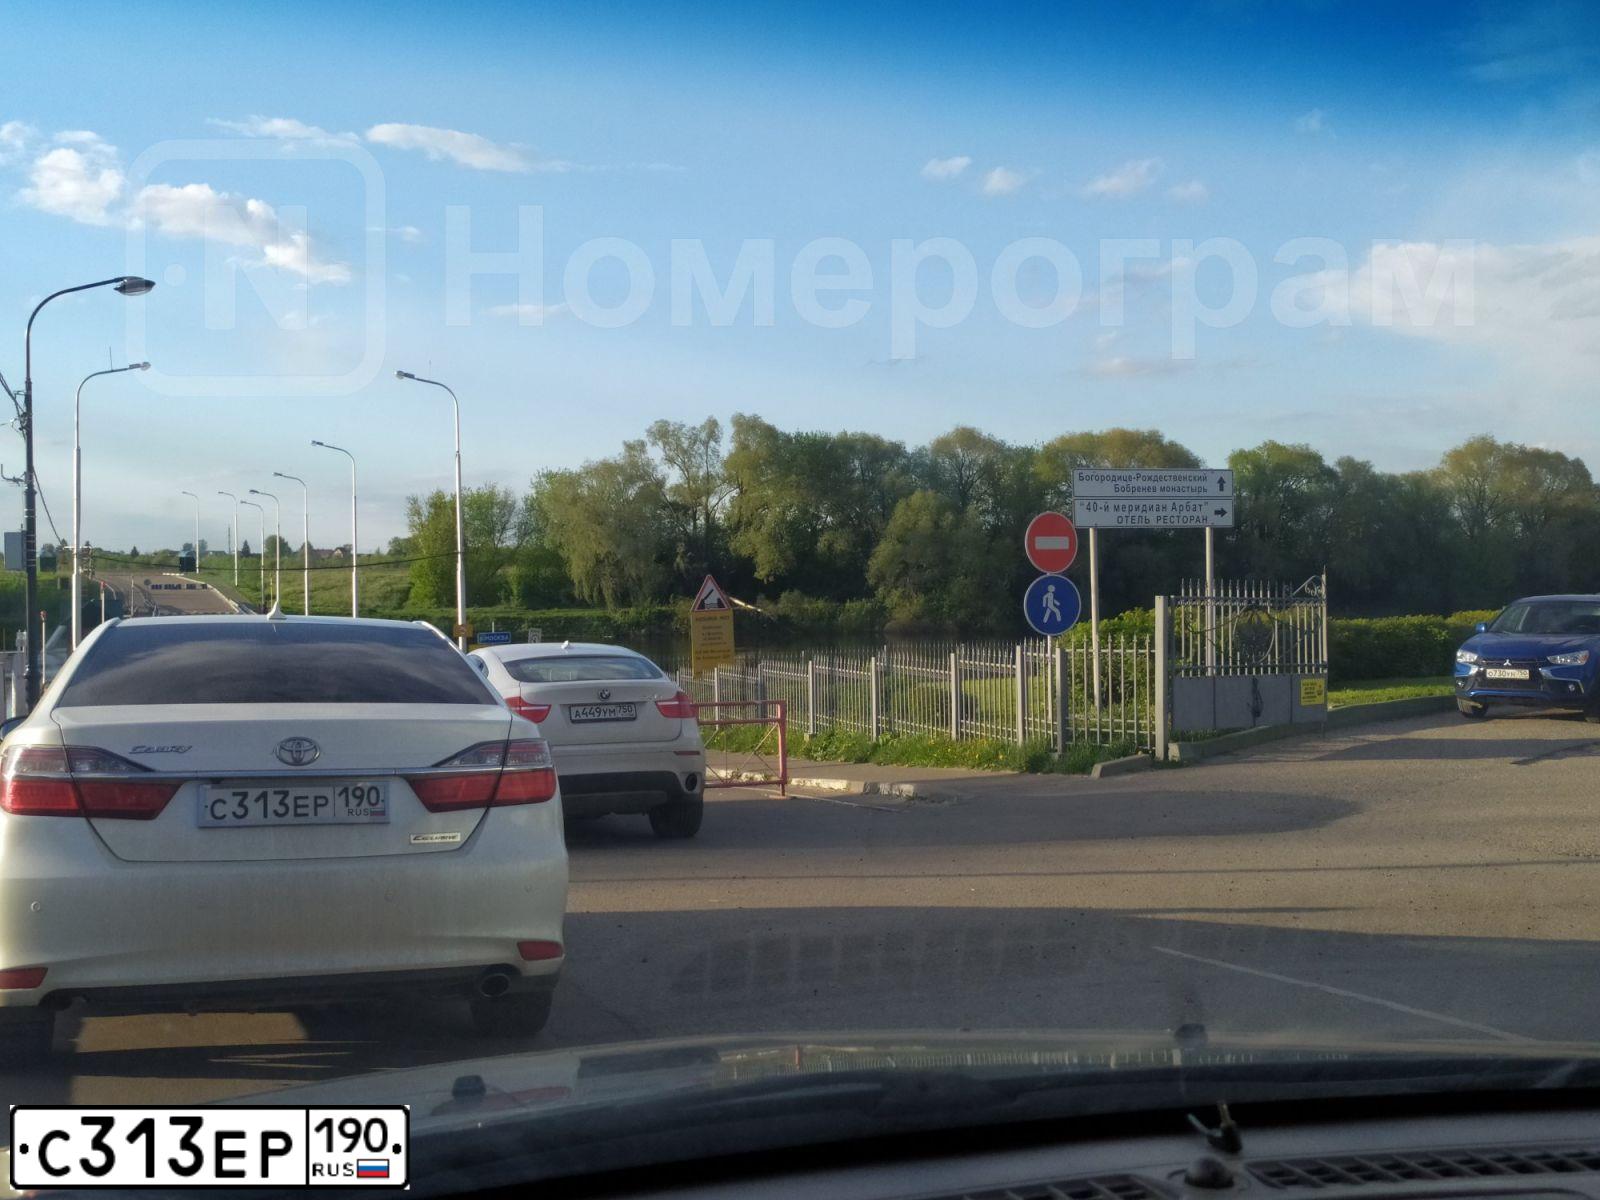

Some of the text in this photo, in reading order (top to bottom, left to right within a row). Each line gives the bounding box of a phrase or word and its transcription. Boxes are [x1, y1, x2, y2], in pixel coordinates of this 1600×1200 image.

[1078, 472, 1208, 483] Богородице-Рождественский
[1114, 484, 1208, 493] Бобренев монастырь
[1113, 503, 1167, 514] меридиан
[1117, 515, 1208, 525] ОТЕЛЬ РЕСТОРАН
[210, 786, 380, 820] С313ЕР 190
[347, 808, 370, 817] RUS
